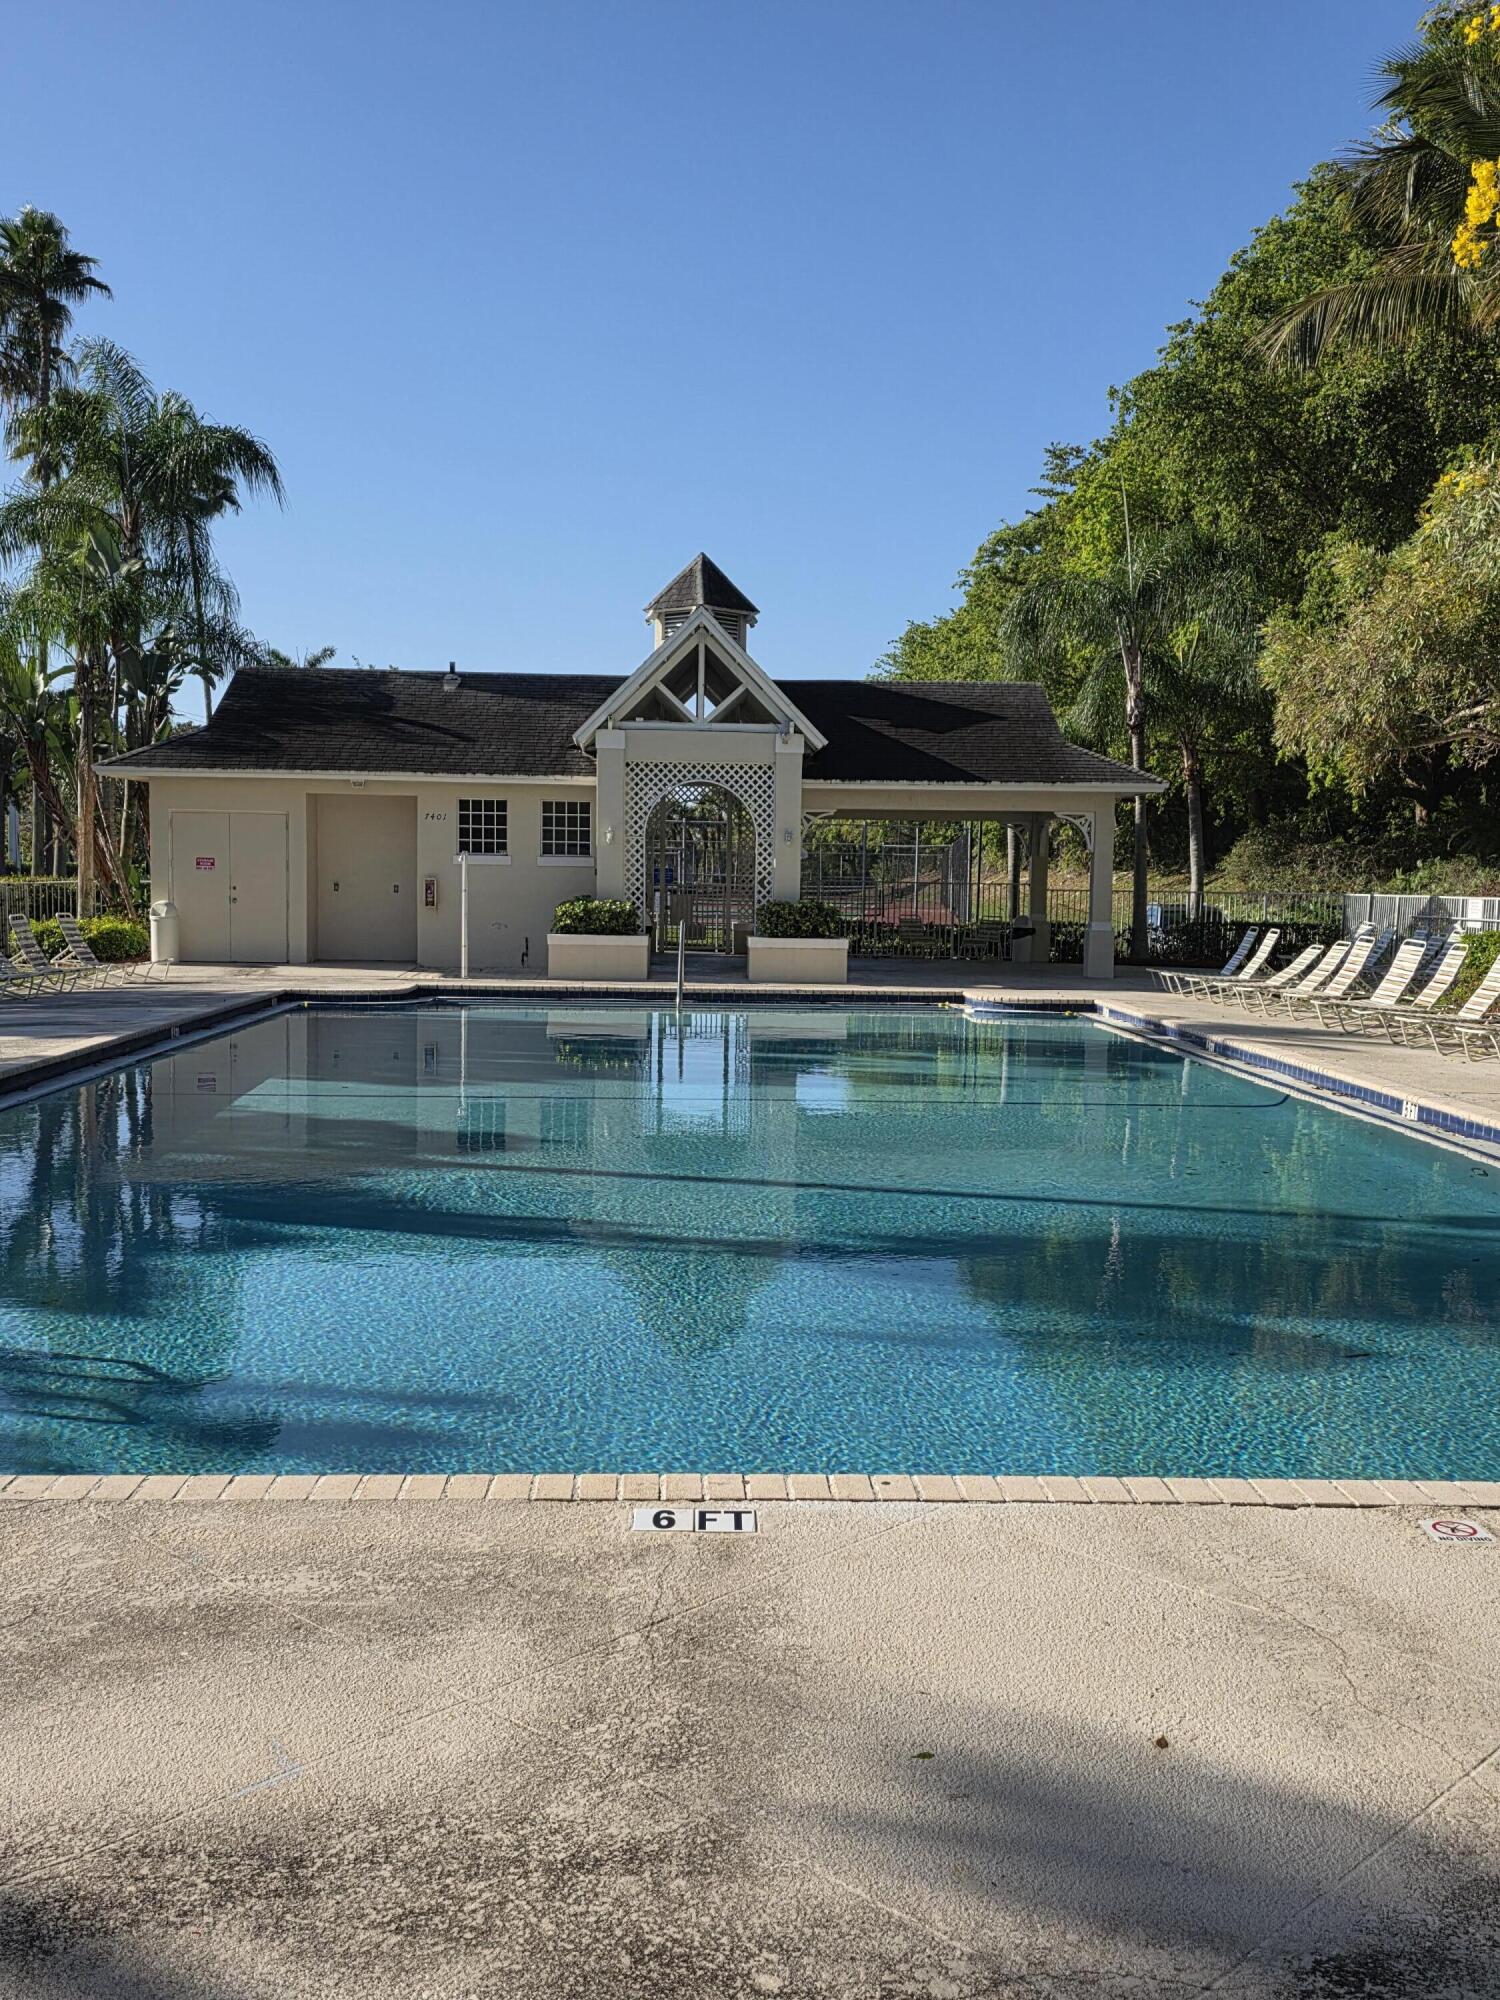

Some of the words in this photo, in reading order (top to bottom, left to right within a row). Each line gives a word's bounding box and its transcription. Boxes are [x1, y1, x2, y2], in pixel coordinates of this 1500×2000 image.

[425, 812, 447, 821] 7401
[652, 1509, 676, 1529] 6
[698, 1510, 752, 1530] FT
